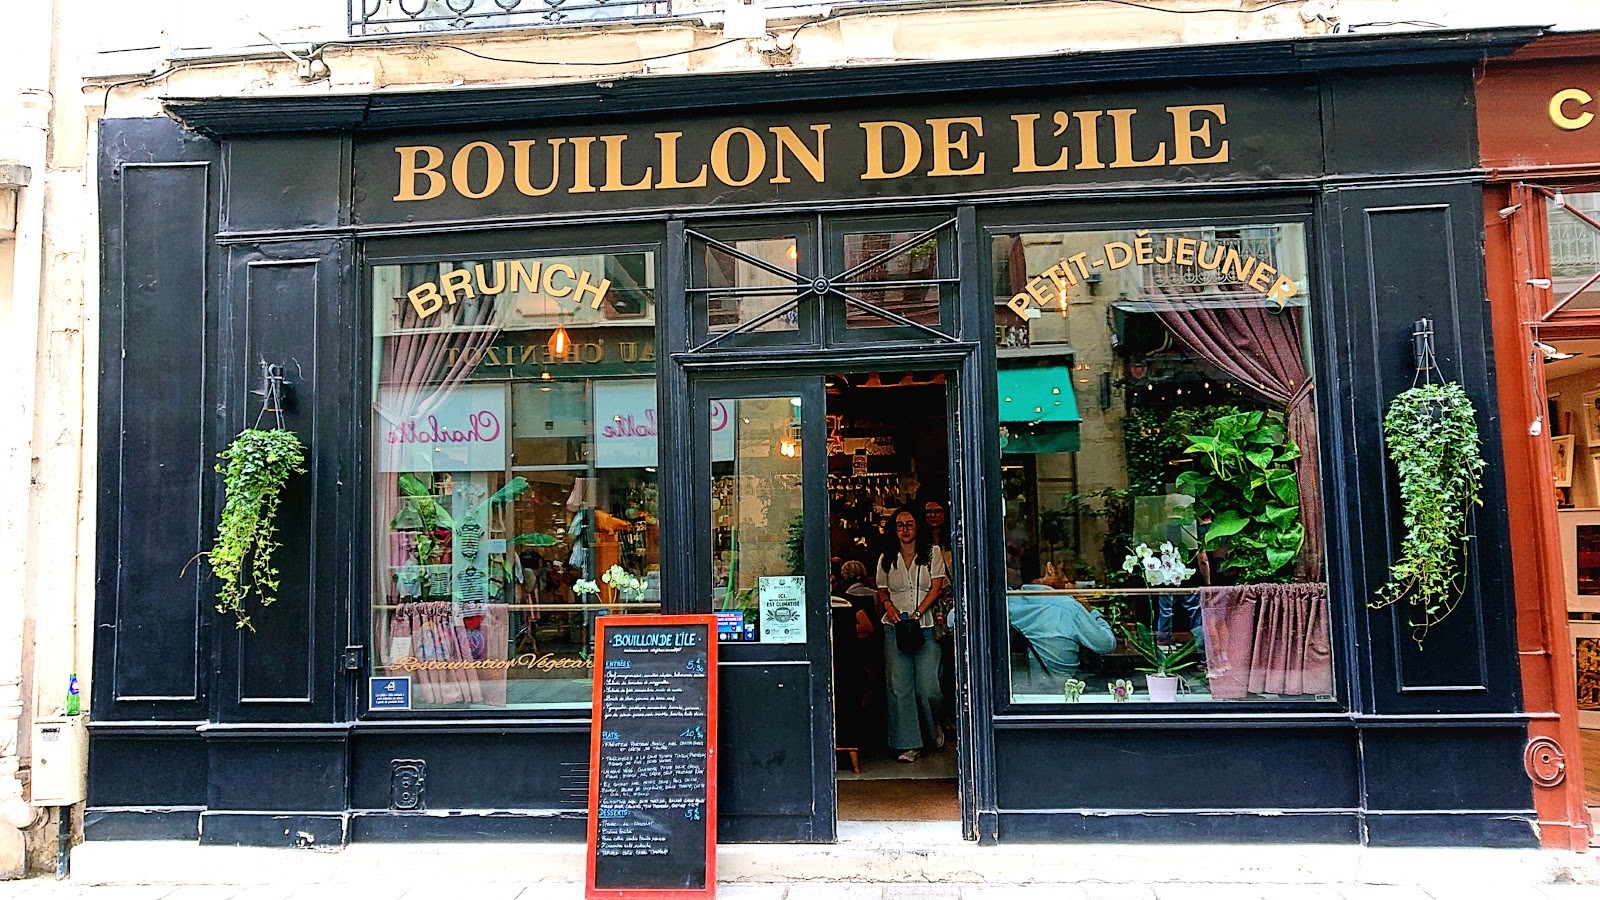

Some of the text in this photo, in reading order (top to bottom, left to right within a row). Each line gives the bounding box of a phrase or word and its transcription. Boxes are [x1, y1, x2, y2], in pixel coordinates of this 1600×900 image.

[1549, 88, 1595, 129] C
[393, 125, 831, 201] BOUILLON
[859, 116, 985, 180] DE
[407, 260, 611, 319] BRUNCH
[1007, 229, 1297, 321] PETIT-DÉJEUNER
[390, 656, 518, 672] Restauration
[613, 634, 659, 647] BOUILLON
[659, 634, 672, 647] DE
